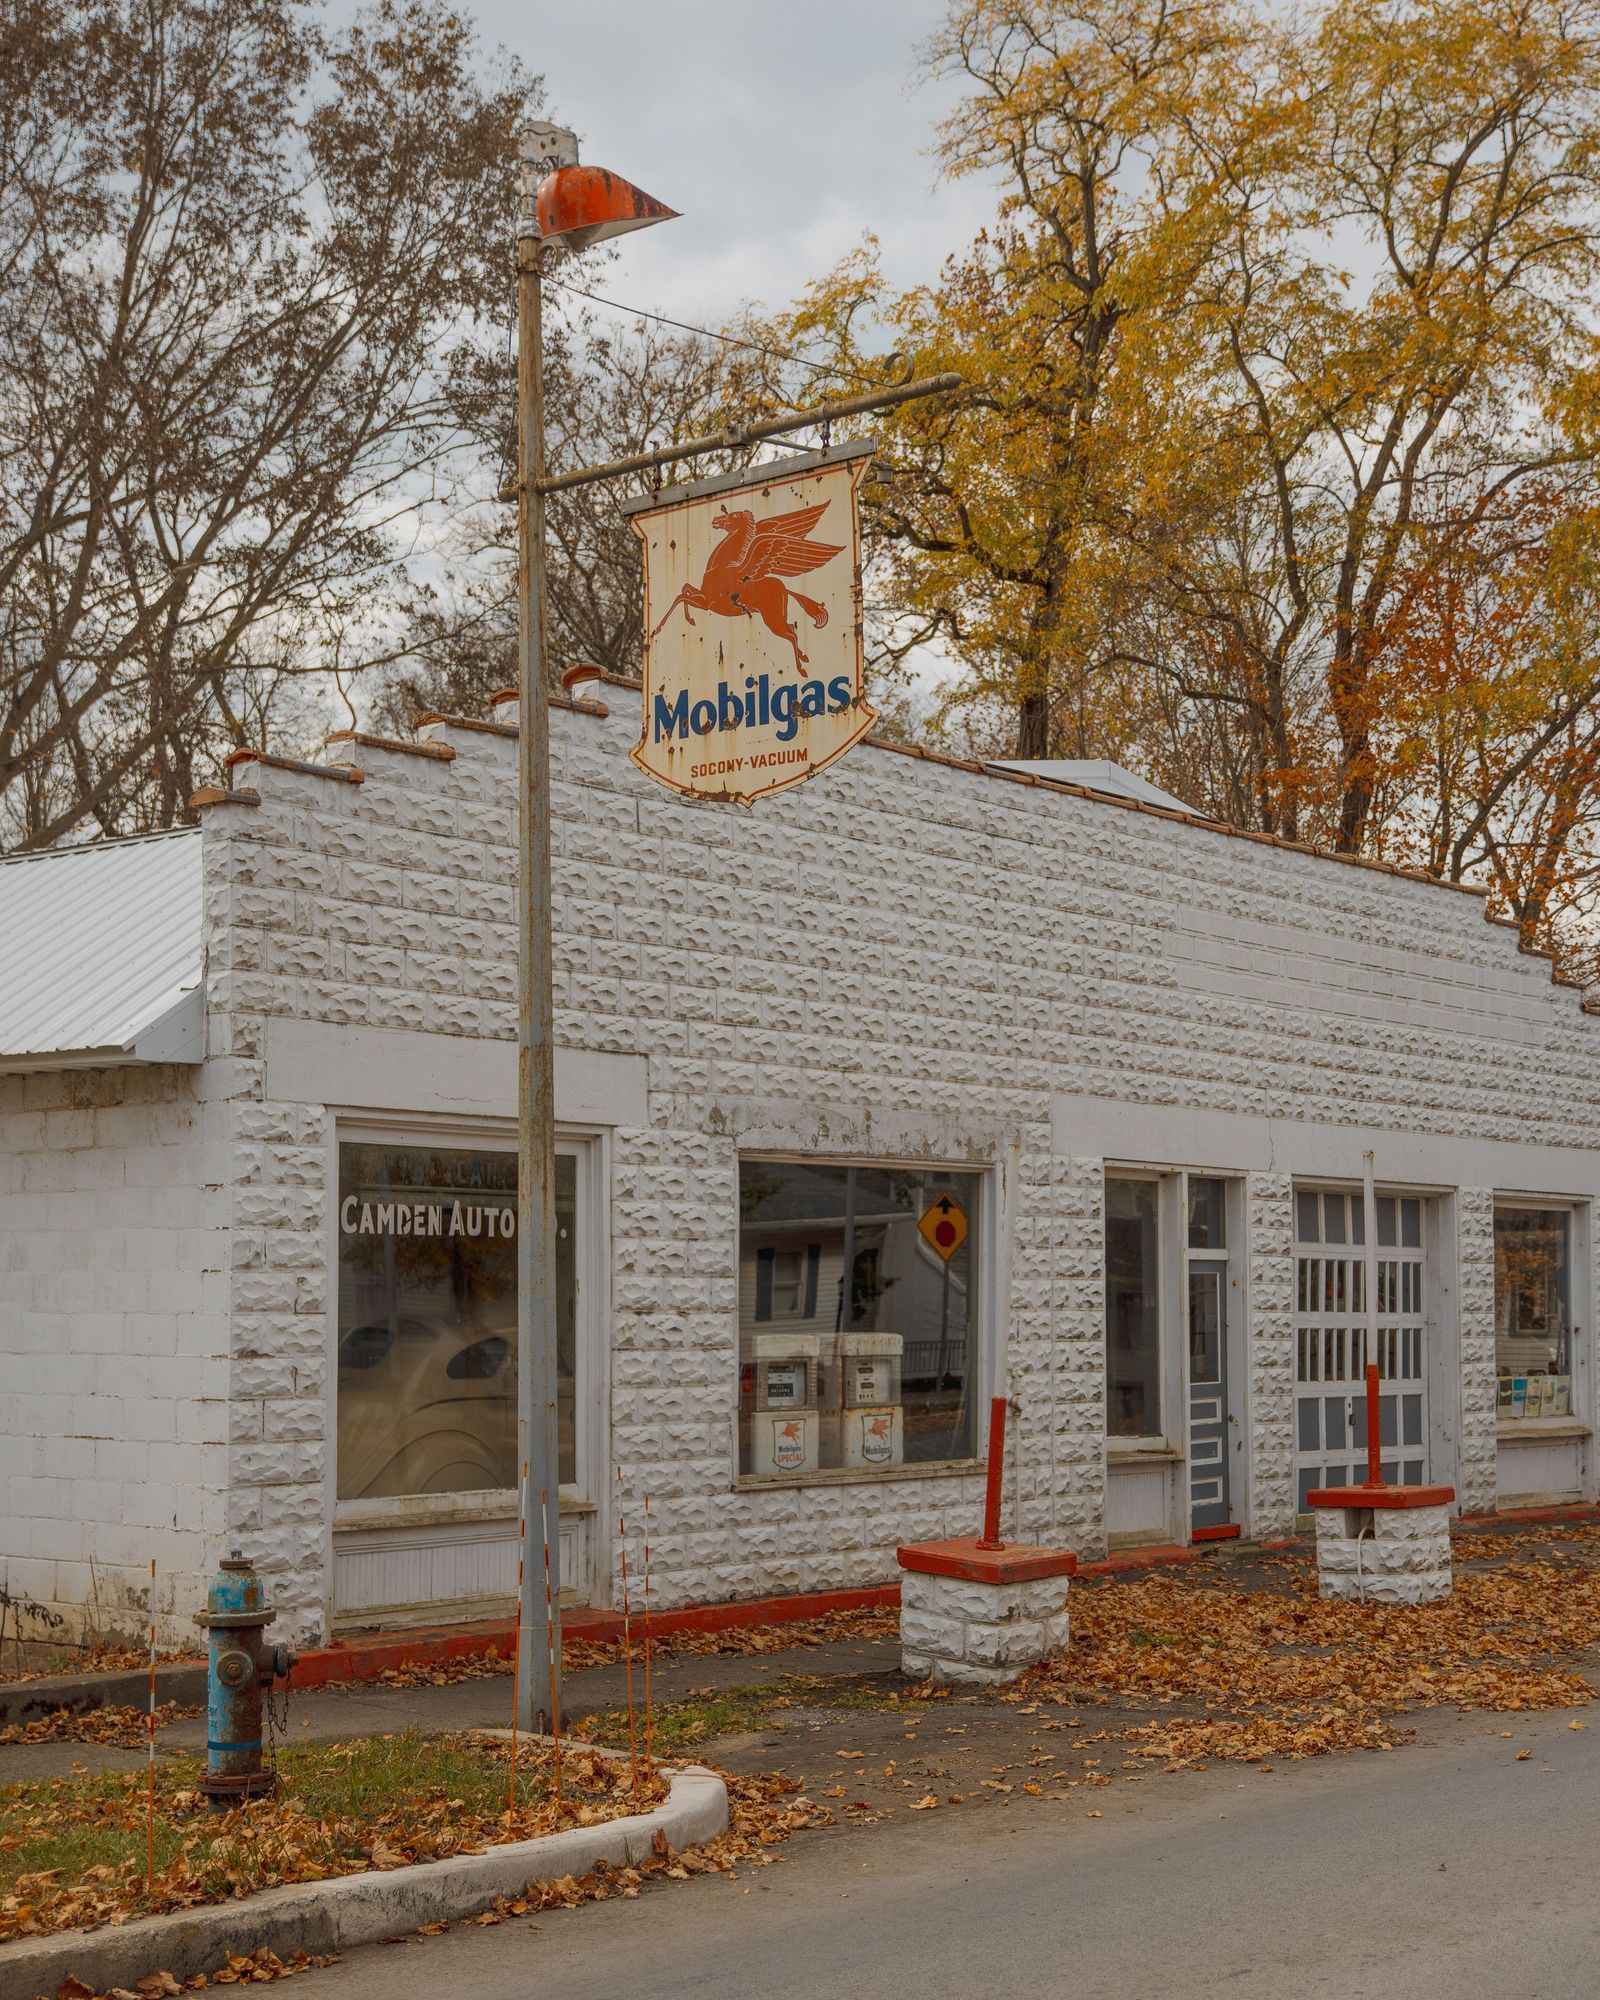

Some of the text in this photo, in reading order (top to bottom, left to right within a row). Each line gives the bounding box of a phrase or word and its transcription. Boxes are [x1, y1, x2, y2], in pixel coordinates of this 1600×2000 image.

[654, 673, 851, 744] Mobilgas
[690, 747, 809, 779] SOCONY-VACUUM
[340, 1194, 443, 1237] CAMDEN
[448, 1199, 516, 1239] AUTO
